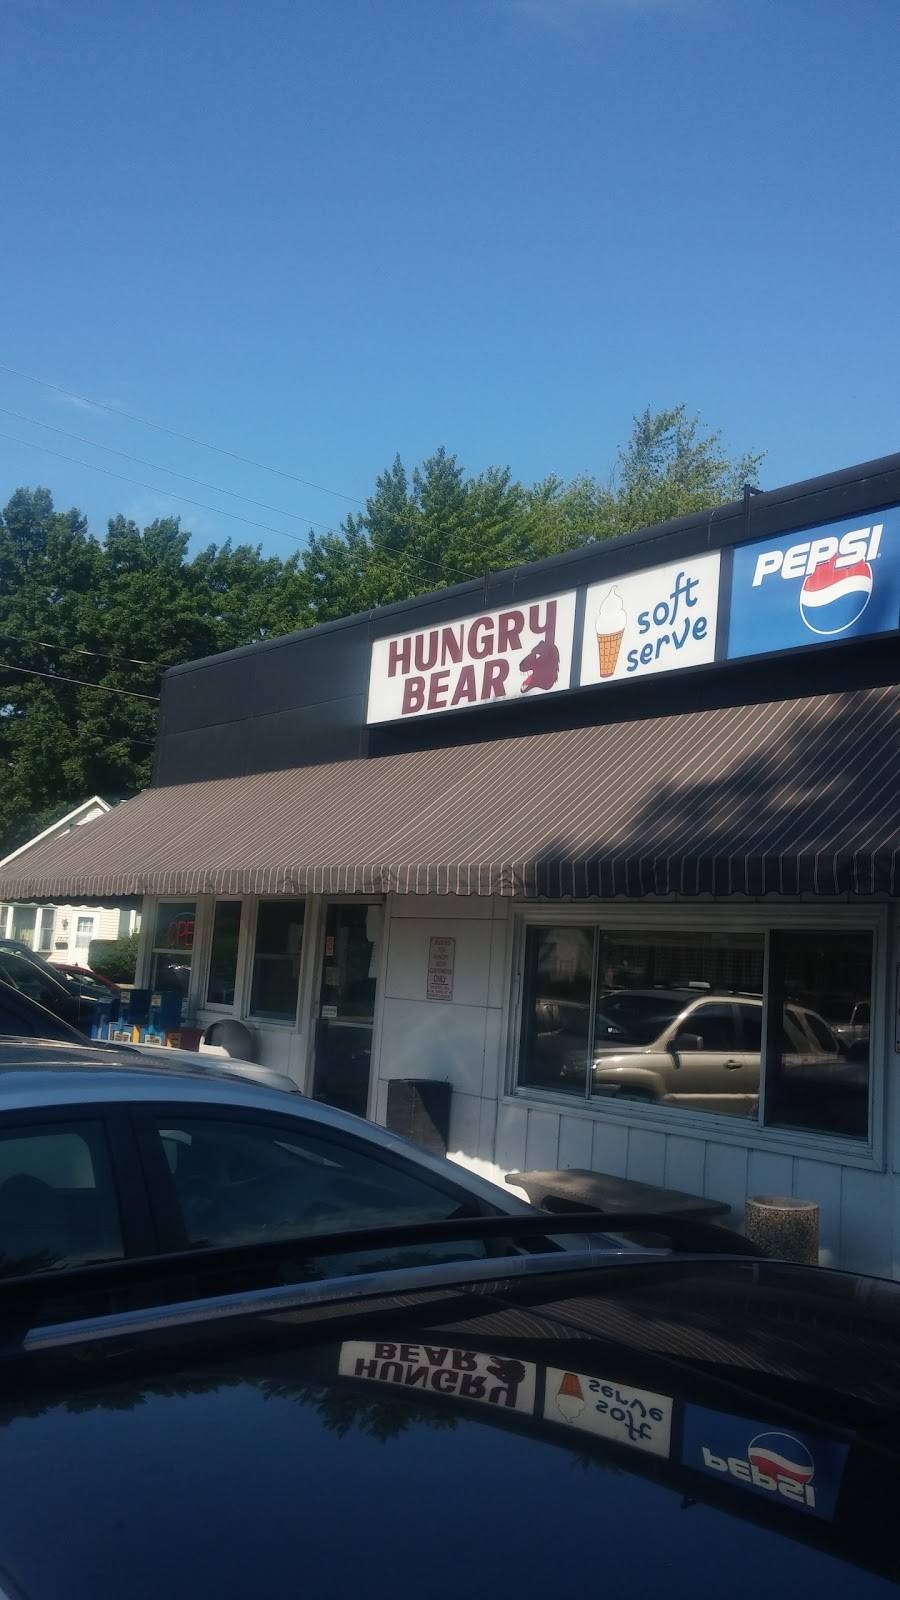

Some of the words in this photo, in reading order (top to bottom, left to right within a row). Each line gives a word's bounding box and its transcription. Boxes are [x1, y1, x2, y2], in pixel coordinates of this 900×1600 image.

[752, 523, 884, 588] PEPSI
[637, 571, 699, 634] soft
[388, 600, 557, 678] HUNGRY
[627, 615, 708, 672] serve
[401, 658, 510, 715] BEAR
